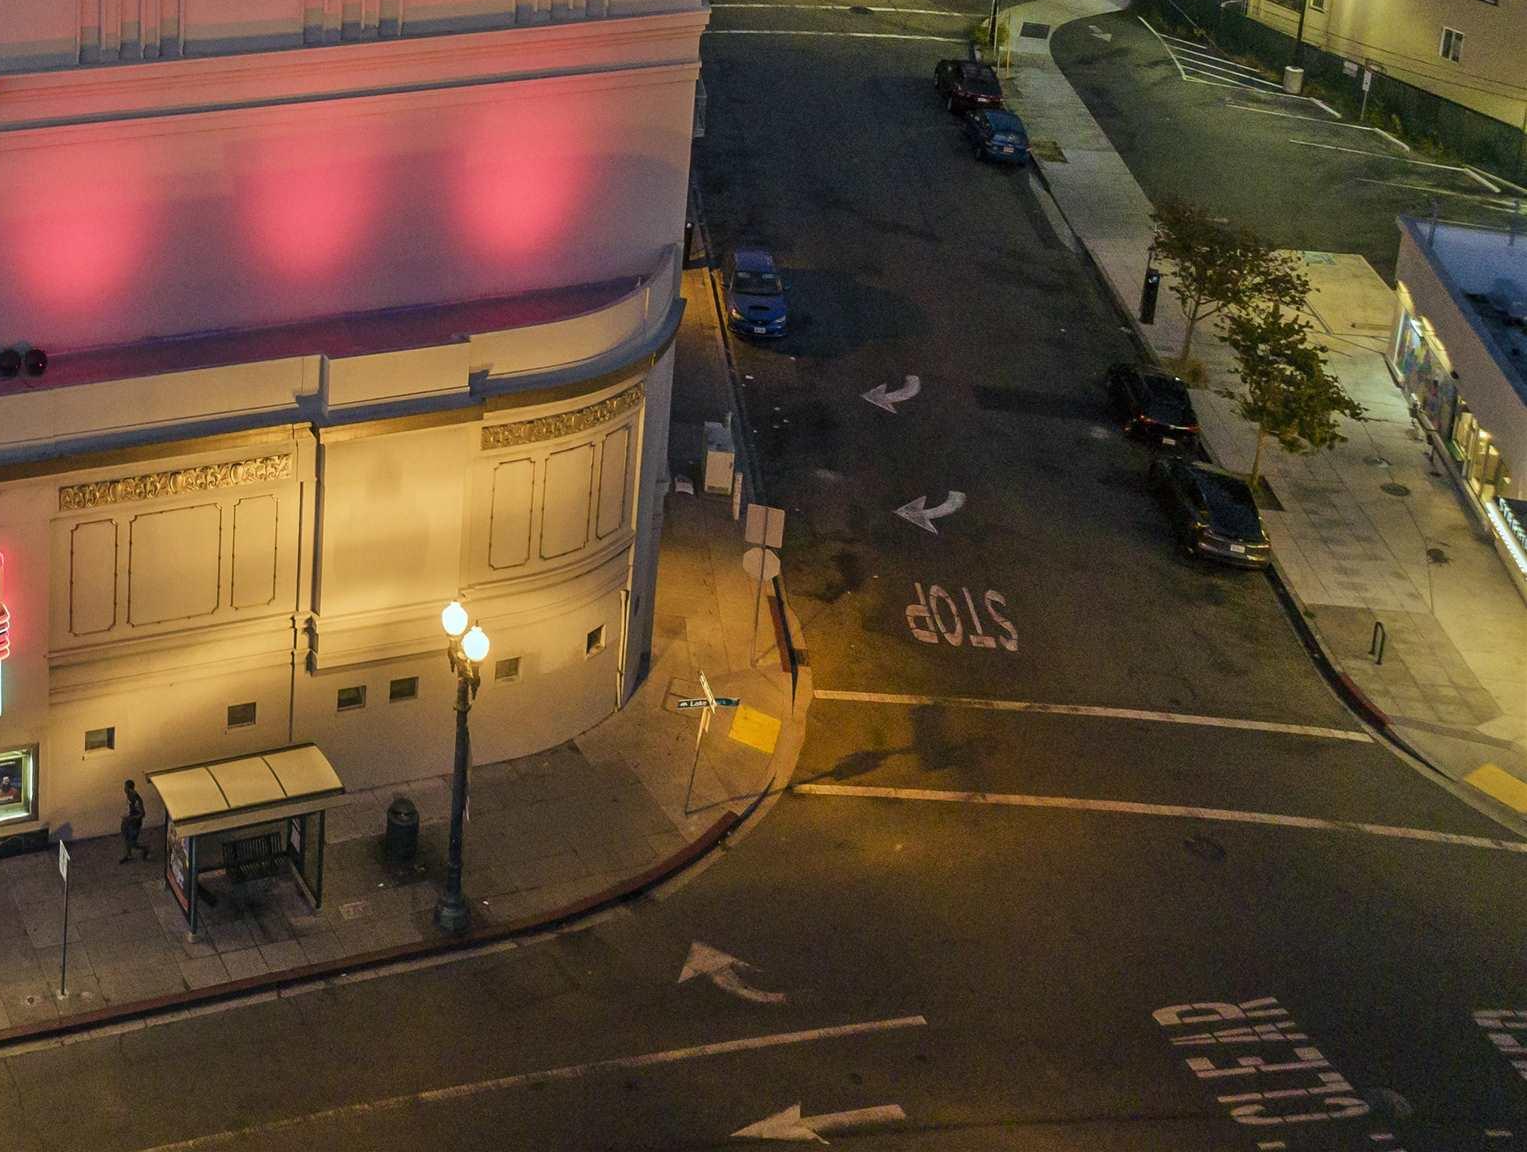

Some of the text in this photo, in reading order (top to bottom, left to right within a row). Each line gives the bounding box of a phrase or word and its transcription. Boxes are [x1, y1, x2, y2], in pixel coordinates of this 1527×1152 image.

[905, 582, 1019, 652] STOP
[689, 699, 708, 708] Lake
[1152, 995, 1370, 1126] CLEAR
